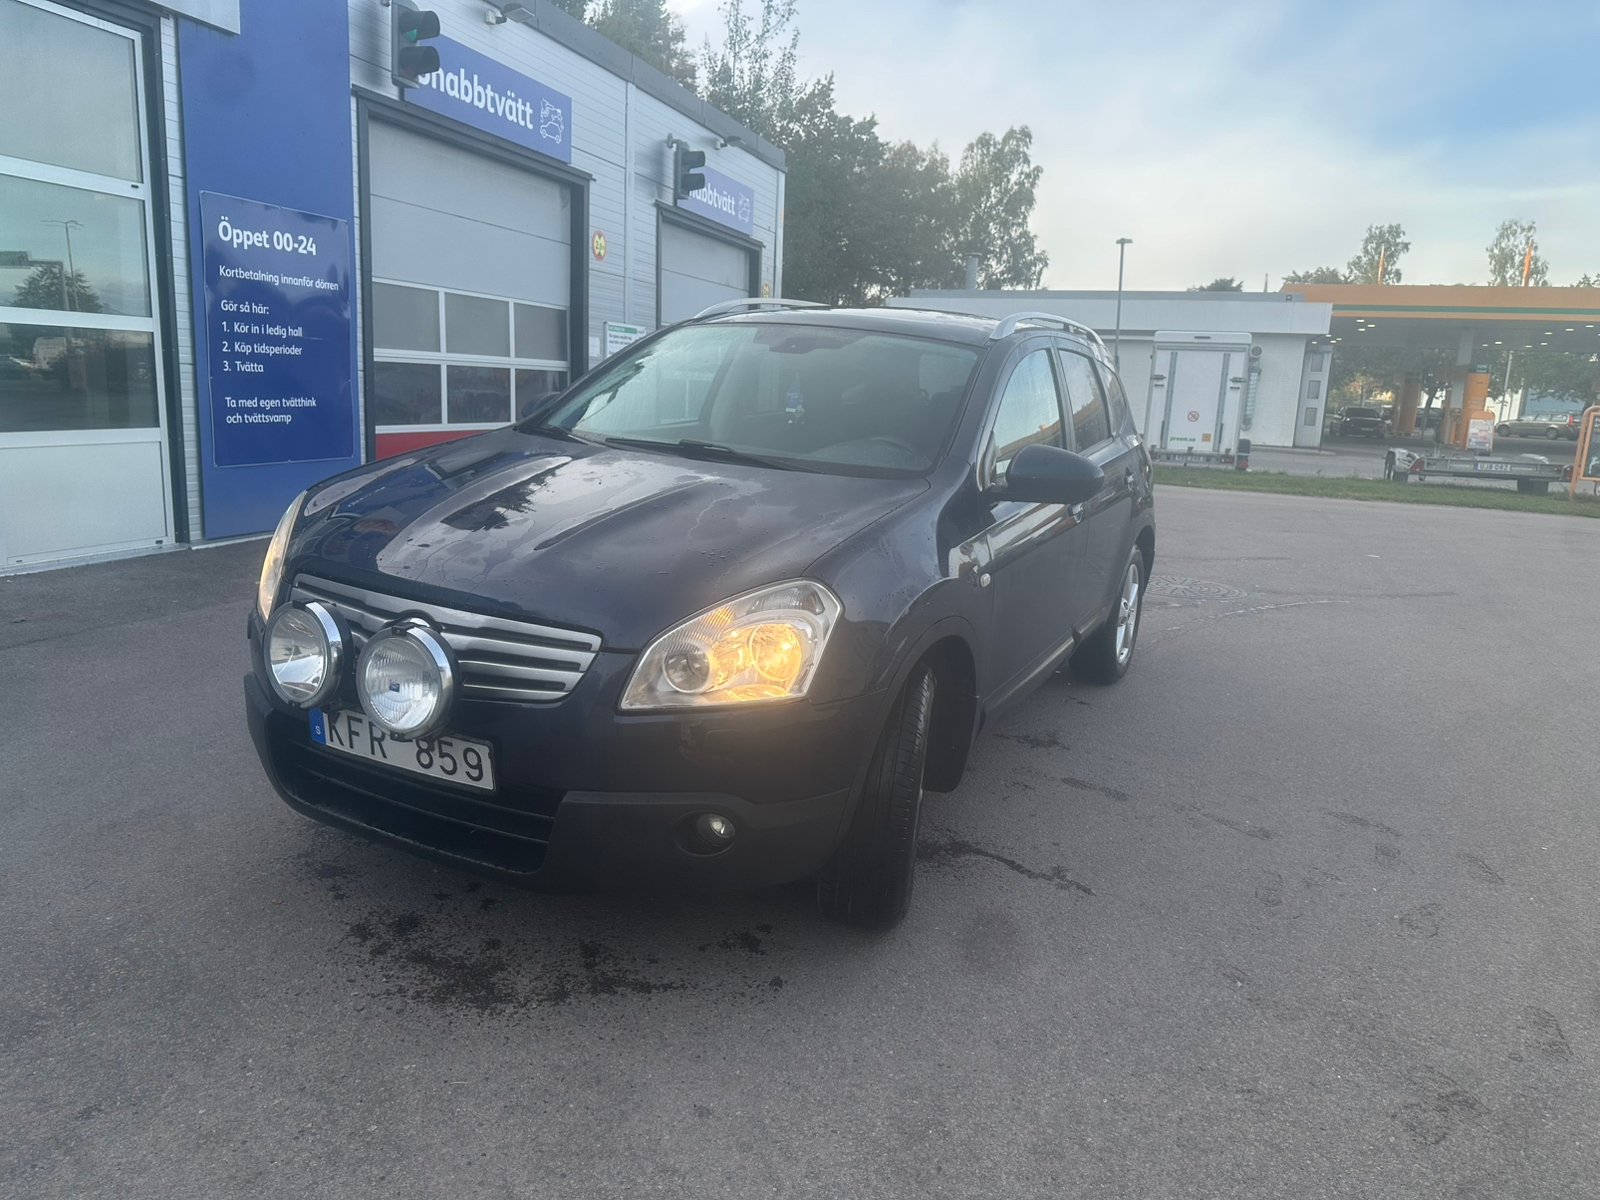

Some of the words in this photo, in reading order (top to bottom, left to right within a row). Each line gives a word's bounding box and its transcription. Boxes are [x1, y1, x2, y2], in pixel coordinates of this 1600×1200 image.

[419, 67, 533, 129] nabbtvätt
[218, 215, 270, 250] Öppet
[273, 230, 316, 255] 00-24
[219, 265, 279, 285] Kortbetalning
[281, 273, 314, 287] innanför
[315, 278, 339, 290] dörren
[221, 300, 237, 311] Gör
[240, 301, 250, 312] så
[252, 303, 269, 314] här:
[222, 321, 230, 332] 1.
[234, 322, 249, 333] Kör
[251, 323, 259, 334] in
[262, 324, 265, 334] i
[266, 324, 286, 338] ledig
[288, 326, 302, 337] hall
[222, 341, 231, 352] 2.
[234, 342, 251, 355] Köp
[254, 343, 302, 356] tidsperioder
[223, 360, 231, 371] 3.
[235, 361, 264, 372] Tvätta
[225, 397, 236, 407] Ta
[238, 397, 257, 407] med
[260, 399, 280, 409] egen
[282, 397, 316, 407] tvätthink
[226, 413, 242, 423] och
[244, 413, 291, 424] tvättsvamp
[315, 725, 321, 735] S
[329, 711, 387, 758] KFR
[416, 737, 483, 782] 859
